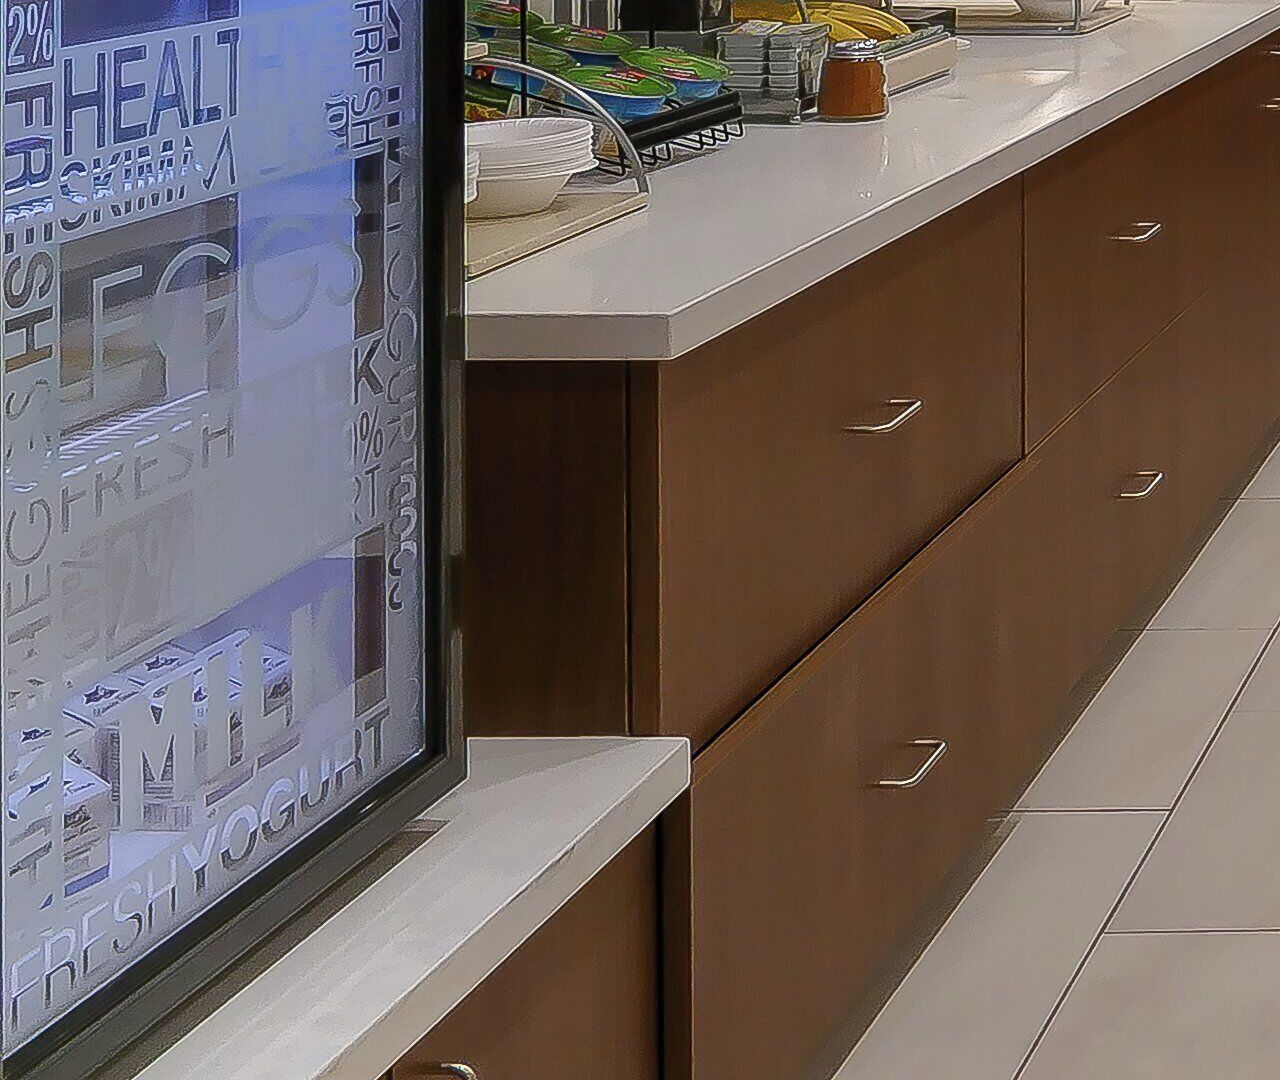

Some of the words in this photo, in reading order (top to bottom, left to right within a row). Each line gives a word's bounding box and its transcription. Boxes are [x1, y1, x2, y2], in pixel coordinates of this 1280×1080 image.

[8, 1, 52, 73] 2%
[9, 857, 180, 1031] FRESH
[182, 707, 390, 894] YOGURT
